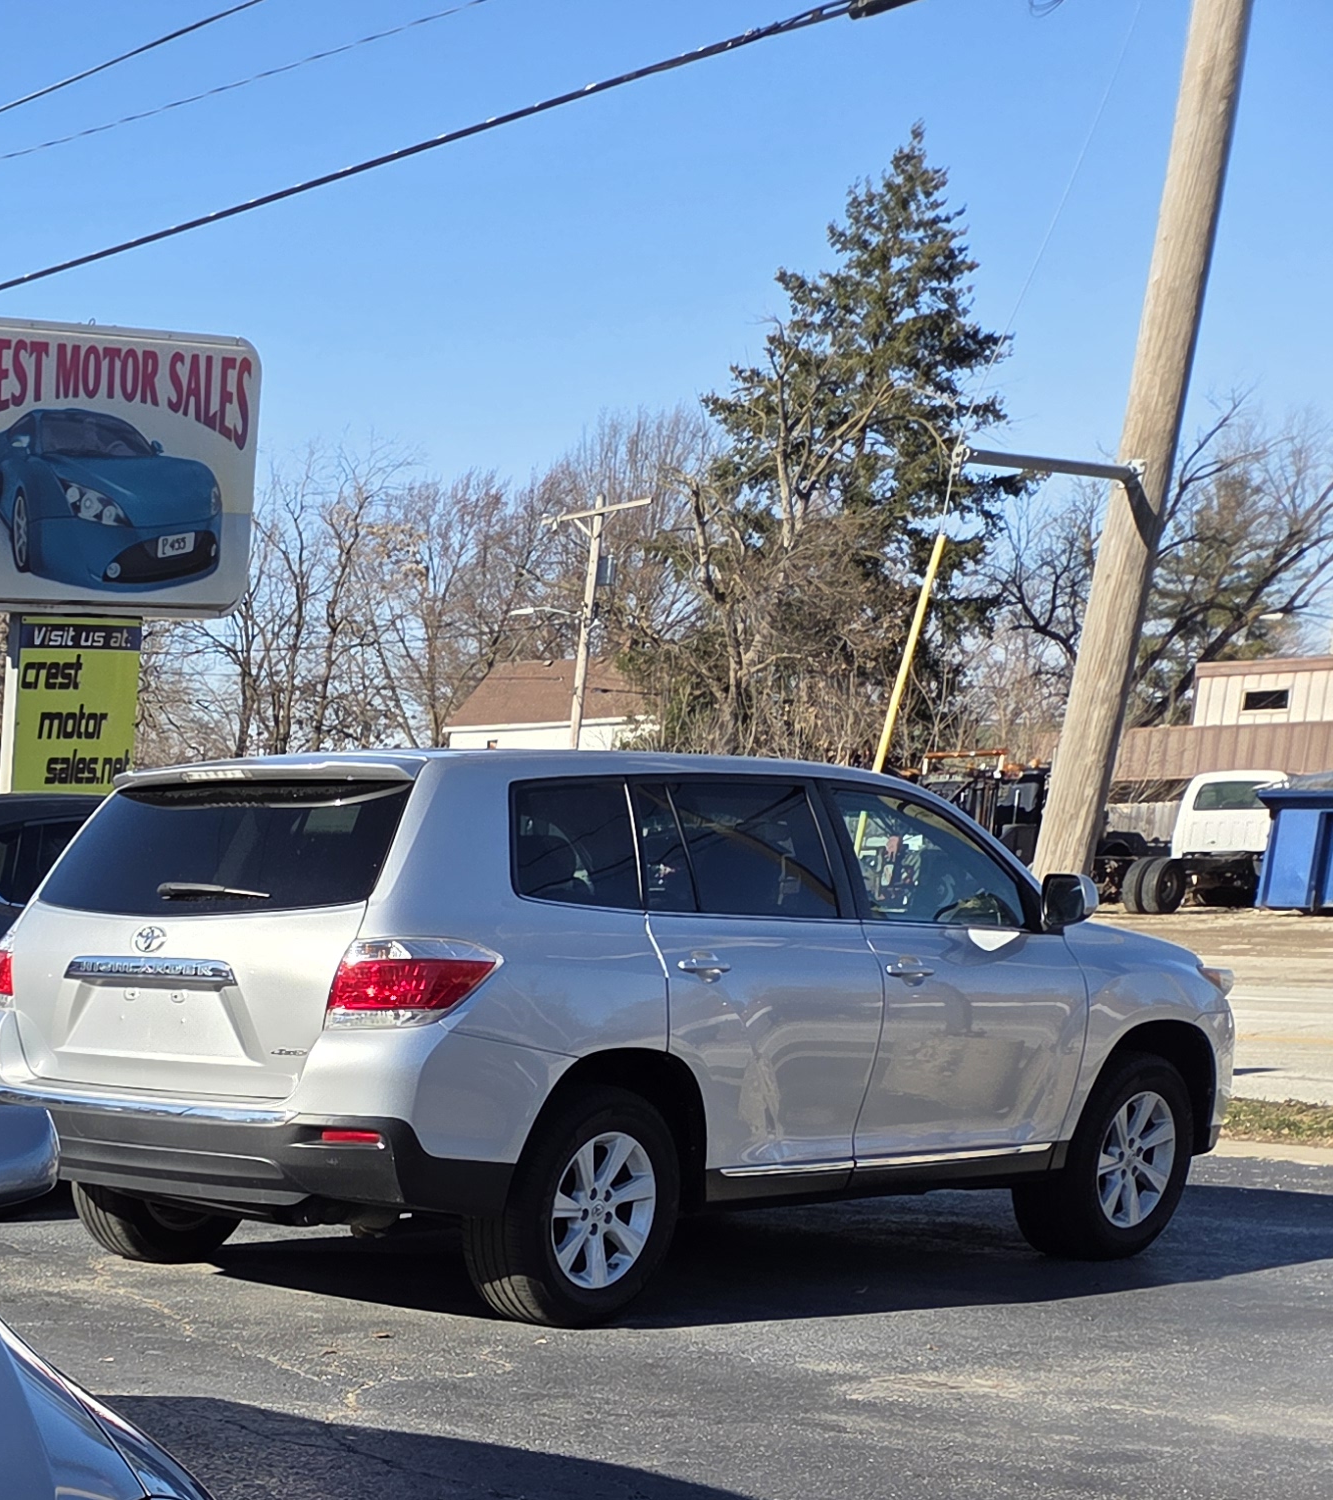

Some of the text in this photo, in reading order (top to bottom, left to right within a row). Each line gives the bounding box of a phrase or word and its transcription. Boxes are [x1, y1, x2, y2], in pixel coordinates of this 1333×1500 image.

[55, 343, 160, 407] MOTOR
[167, 351, 252, 450] SALES
[33, 626, 132, 647] Visit us at:
[21, 654, 83, 690] crest
[37, 703, 108, 739] motor
[44, 749, 130, 784] sales.net
